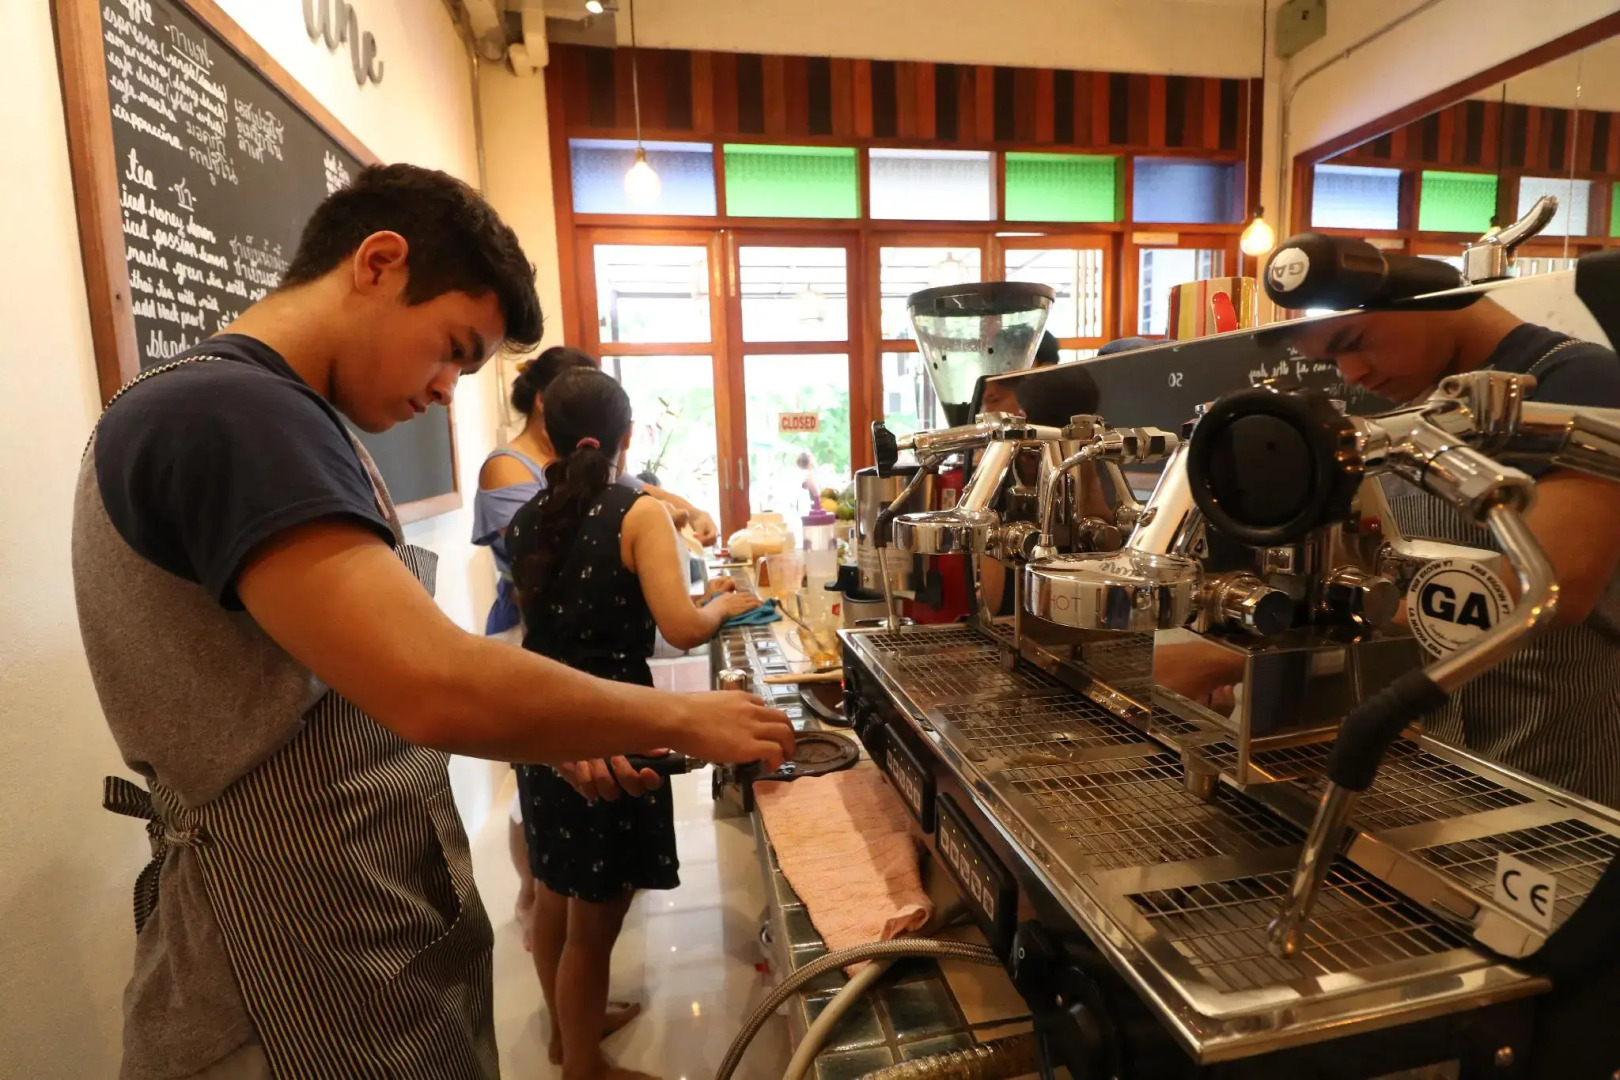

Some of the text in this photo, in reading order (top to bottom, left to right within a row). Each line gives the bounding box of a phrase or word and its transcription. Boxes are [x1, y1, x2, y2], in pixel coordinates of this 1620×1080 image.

[125, 148, 157, 191] tea
[120, 184, 148, 215] iced
[148, 199, 186, 239] honey
[123, 210, 150, 240] iced
[132, 299, 157, 319] add
[781, 416, 816, 430] CLOSED
[1421, 582, 1491, 631] GA
[1502, 870, 1550, 917] CE
